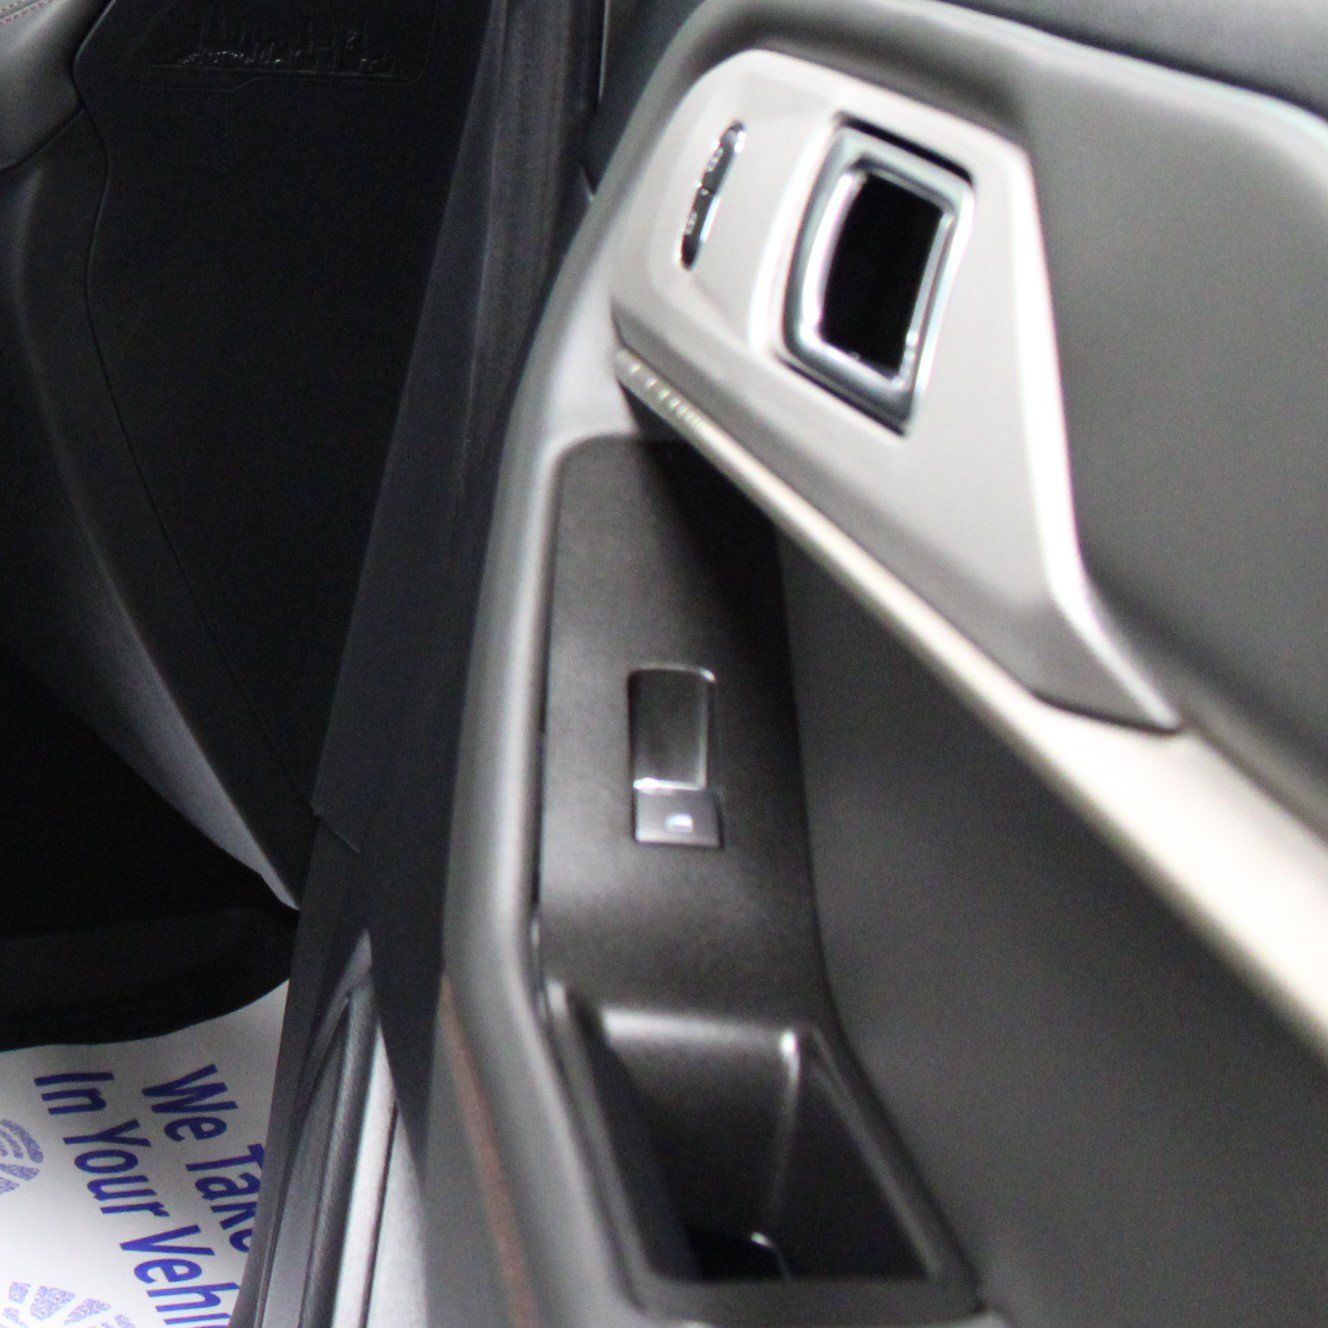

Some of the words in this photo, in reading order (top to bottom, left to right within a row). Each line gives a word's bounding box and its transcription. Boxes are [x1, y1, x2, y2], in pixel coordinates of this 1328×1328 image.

[33, 1072, 115, 1115] In
[142, 1063, 239, 1142] We
[62, 1119, 170, 1217] Your
[119, 1224, 240, 1328] Vehi
